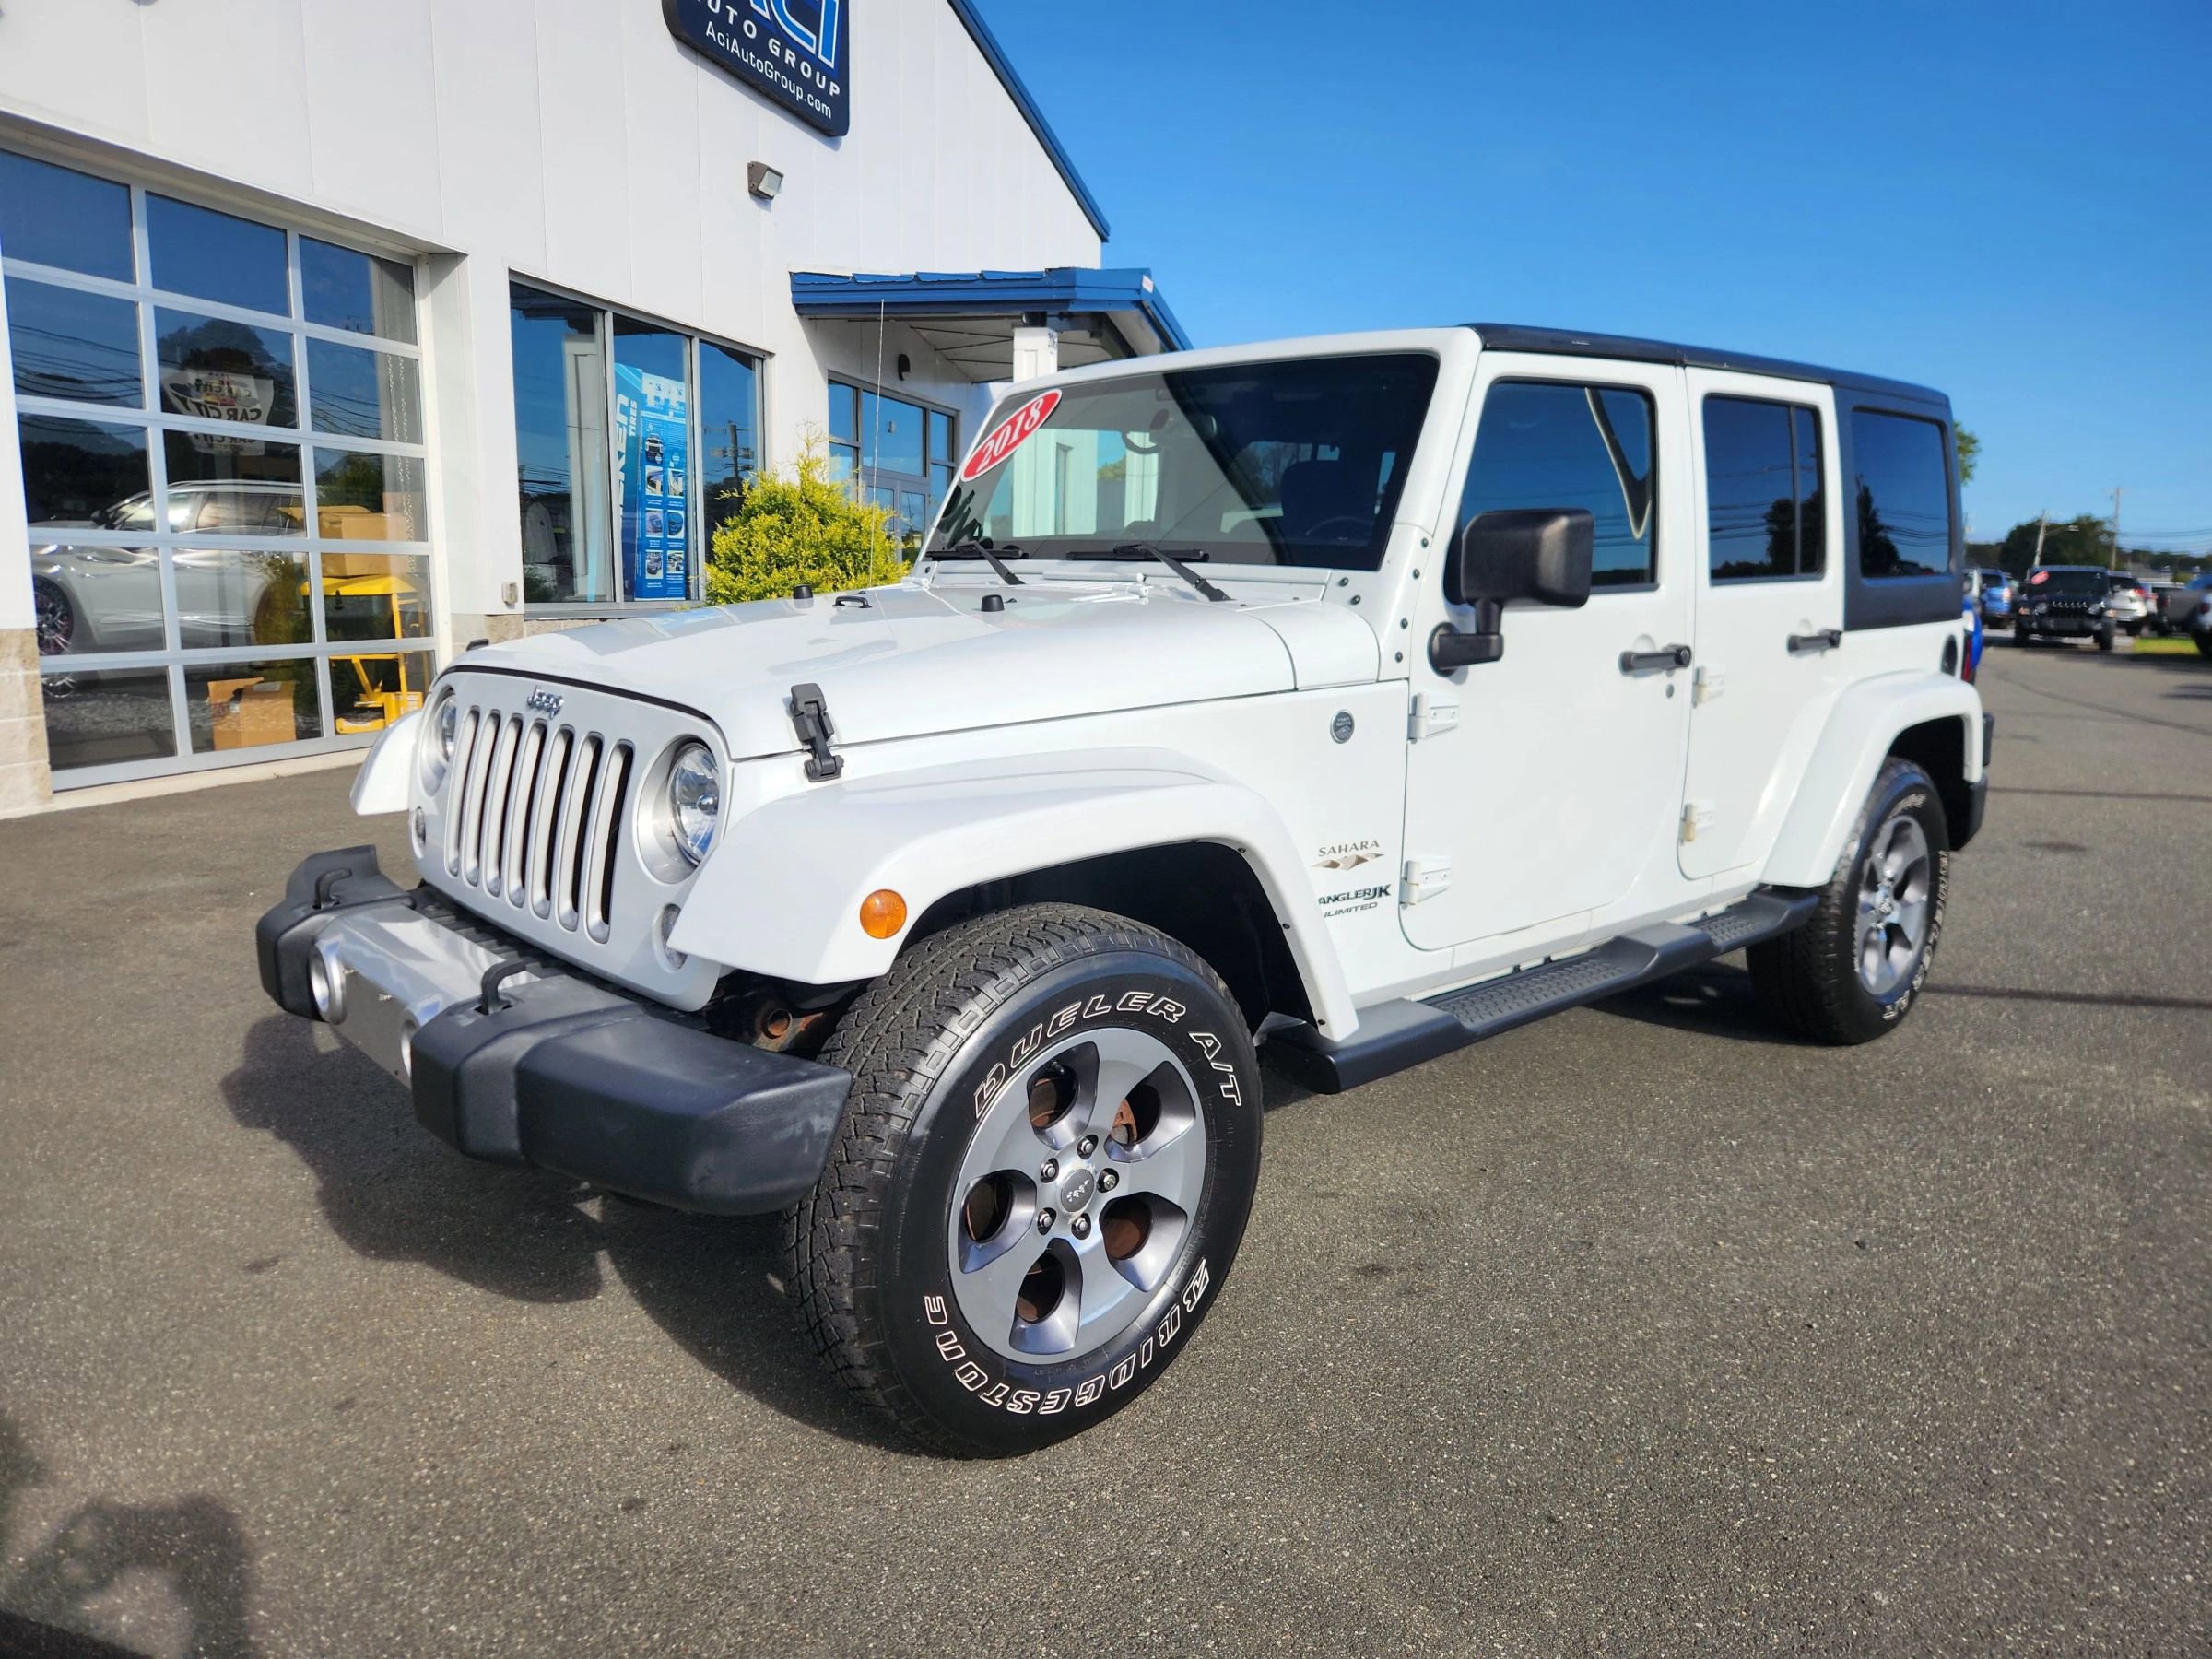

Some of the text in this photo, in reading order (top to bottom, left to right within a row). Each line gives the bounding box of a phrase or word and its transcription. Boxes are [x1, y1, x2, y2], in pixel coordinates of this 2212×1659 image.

[695, 0, 841, 97] UTO GROUP
[705, 20, 833, 120] AciAutoGroup.com
[629, 399, 639, 438] TIRES
[975, 396, 1045, 474] 2018
[526, 685, 565, 720] Jeep
[1317, 840, 1381, 858] SAHARA
[1324, 900, 1379, 918] LIMITED
[973, 990, 1243, 1120] DUELER A/T
[923, 1256, 1211, 1417] BRIDGESTONE
